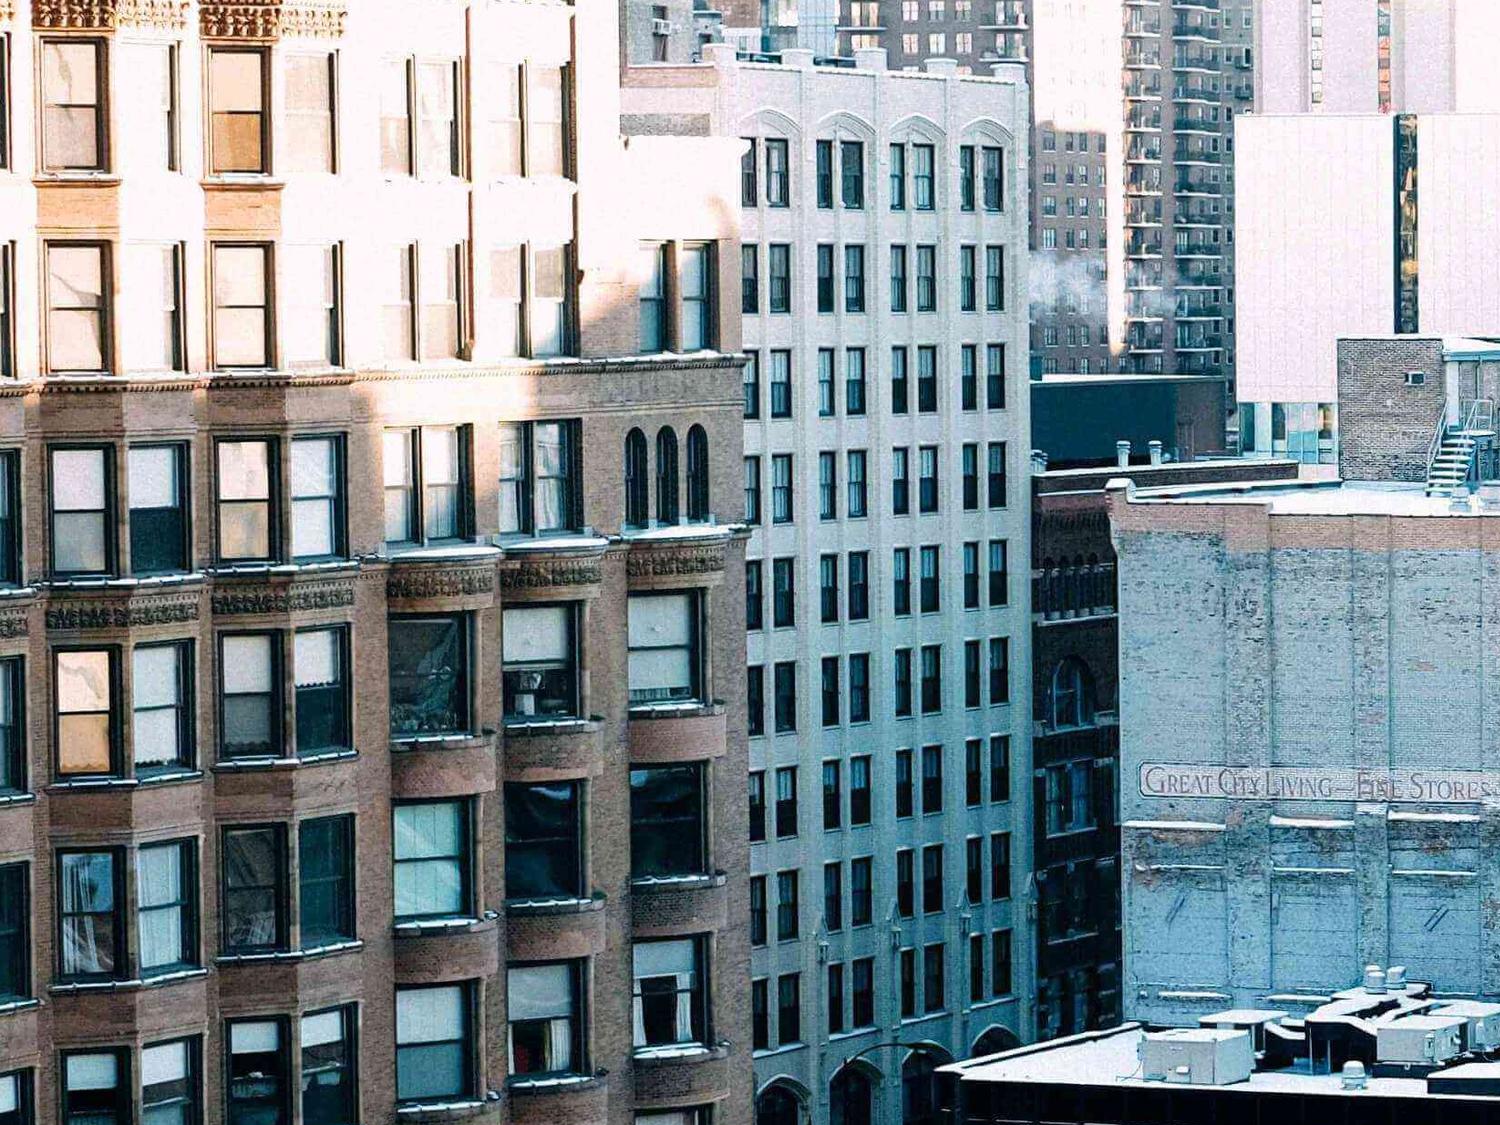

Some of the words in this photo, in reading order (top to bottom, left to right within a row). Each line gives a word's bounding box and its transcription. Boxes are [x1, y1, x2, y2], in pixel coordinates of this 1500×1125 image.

[1145, 766, 1213, 794] GREAT
[1217, 768, 1260, 797] CITY
[1265, 770, 1332, 798] LIVING
[1408, 772, 1490, 801] STORES
